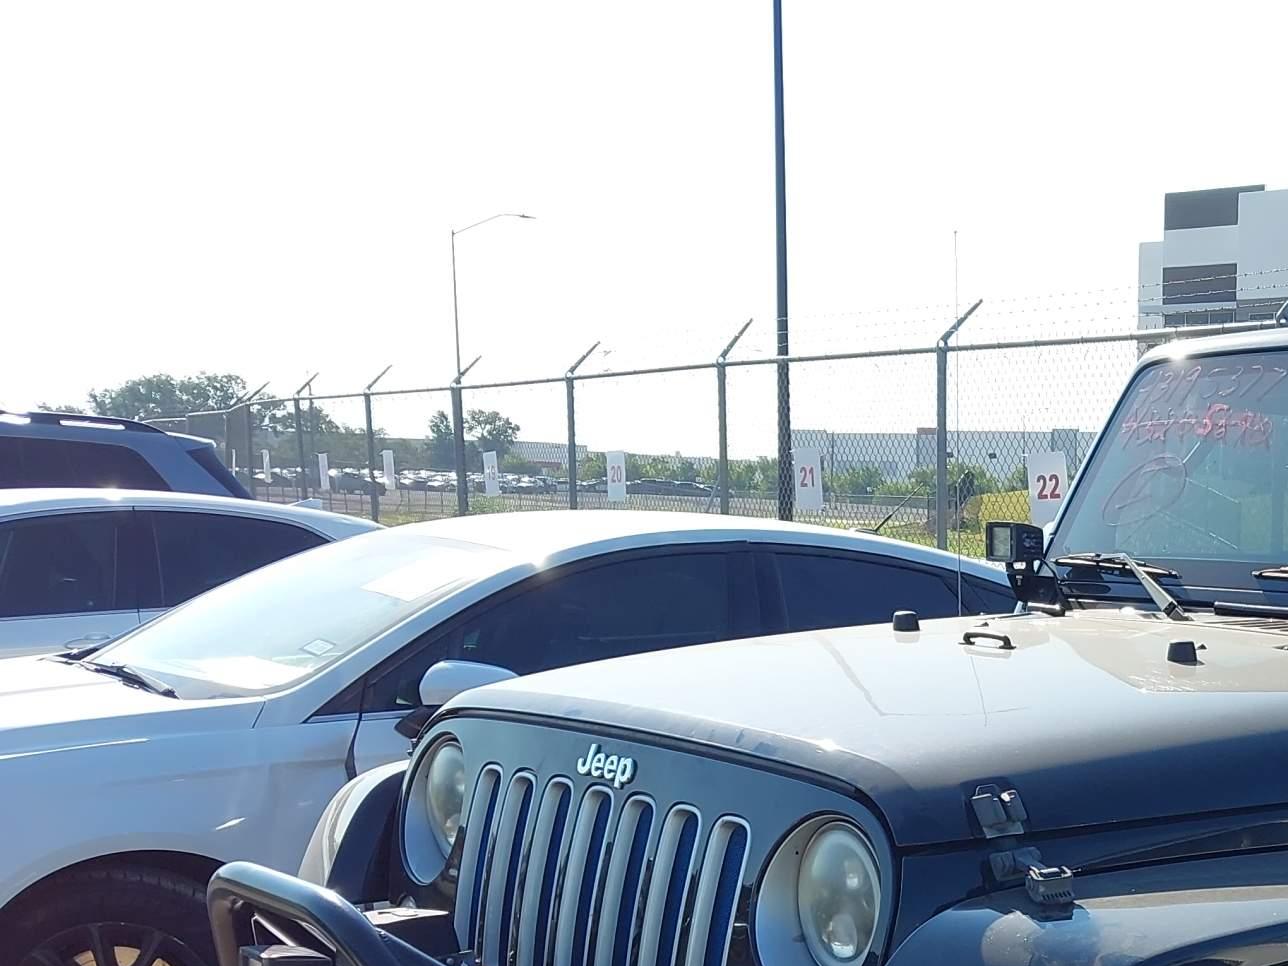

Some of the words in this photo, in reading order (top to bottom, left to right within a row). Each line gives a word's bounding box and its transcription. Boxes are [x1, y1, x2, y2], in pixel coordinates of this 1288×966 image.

[610, 465, 622, 483] 20
[799, 466, 815, 487] 21
[1036, 474, 1062, 500] 22
[576, 743, 634, 789] Jeep
